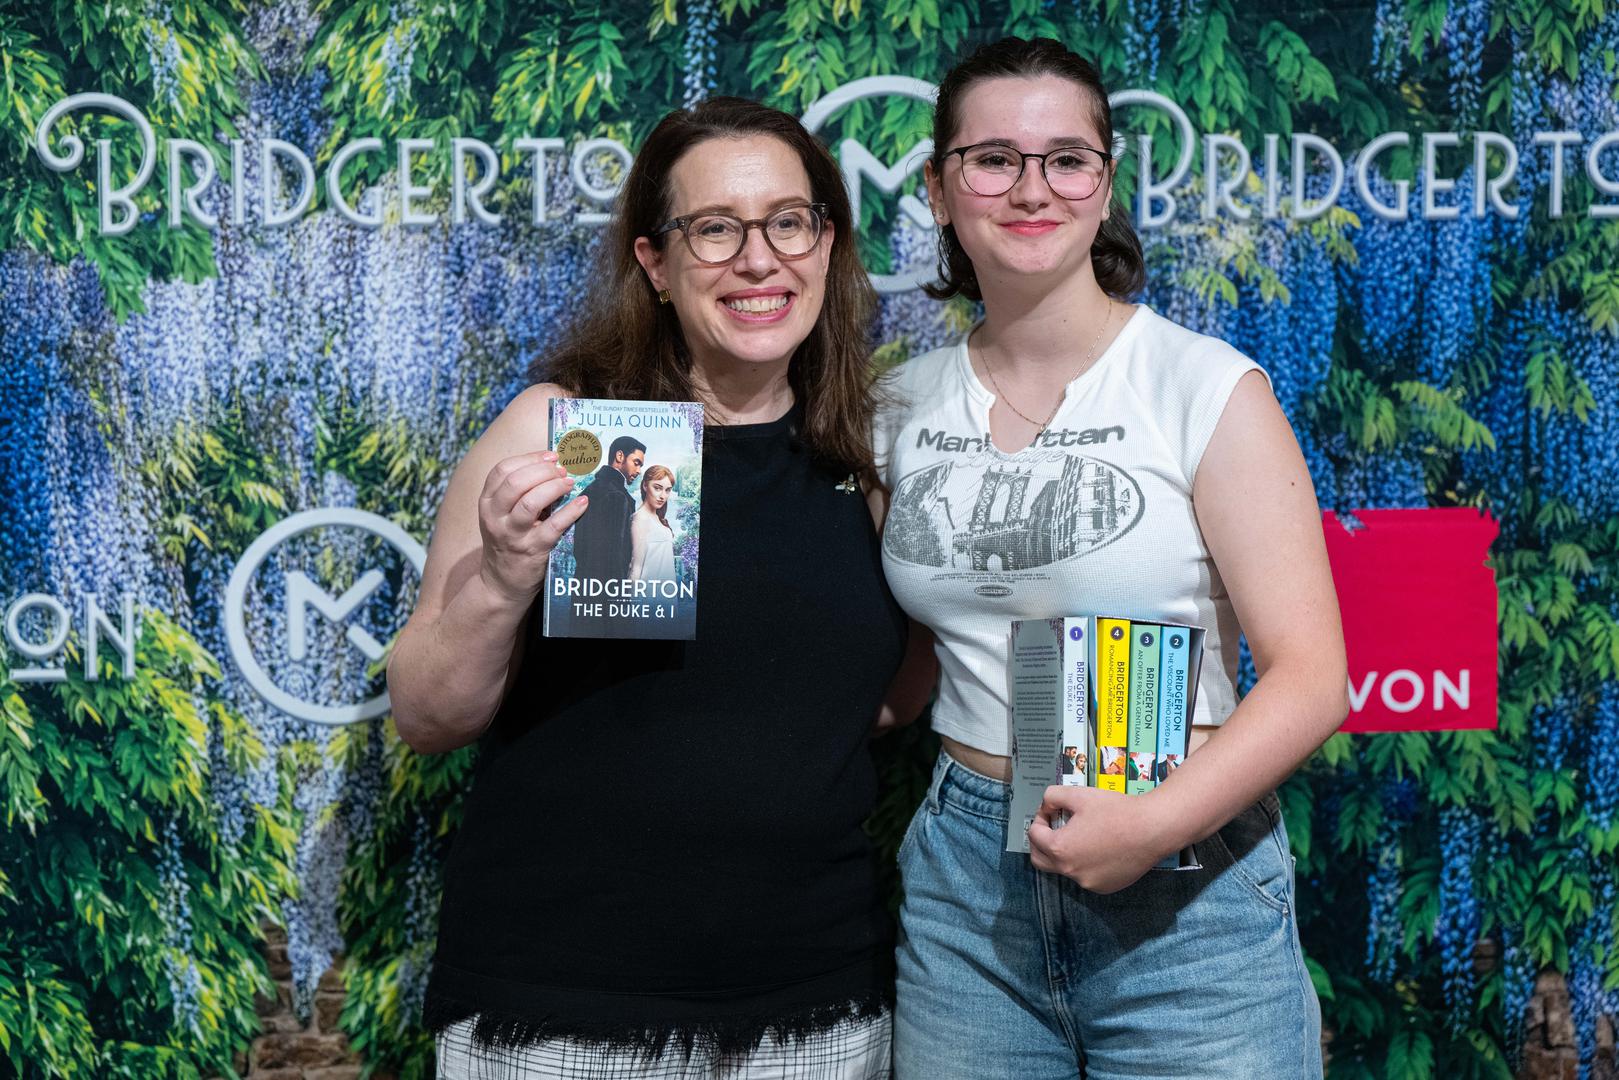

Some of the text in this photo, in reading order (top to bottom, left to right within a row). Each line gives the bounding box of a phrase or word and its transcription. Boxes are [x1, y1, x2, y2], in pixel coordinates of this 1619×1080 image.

[578, 413, 681, 428] JULIA QUINN
[560, 432, 599, 454] AUTOGRAPHED
[916, 425, 1125, 453] Manttan
[562, 452, 598, 465] author
[554, 578, 694, 598] BRIDGERTON
[574, 603, 674, 618] THE DUKE & I
[1114, 629, 1120, 637] 4
[1144, 636, 1149, 644] 3
[1174, 638, 1179, 646] 2
[1138, 650, 1143, 660] AN
[1076, 661, 1085, 723] BRIDGERTON
[1115, 661, 1125, 723] BRIDGERTON
[1145, 667, 1154, 729] BRIDGERTON
[1174, 669, 1184, 731] BRIDGERTON
[1164, 738, 1170, 747] ME
